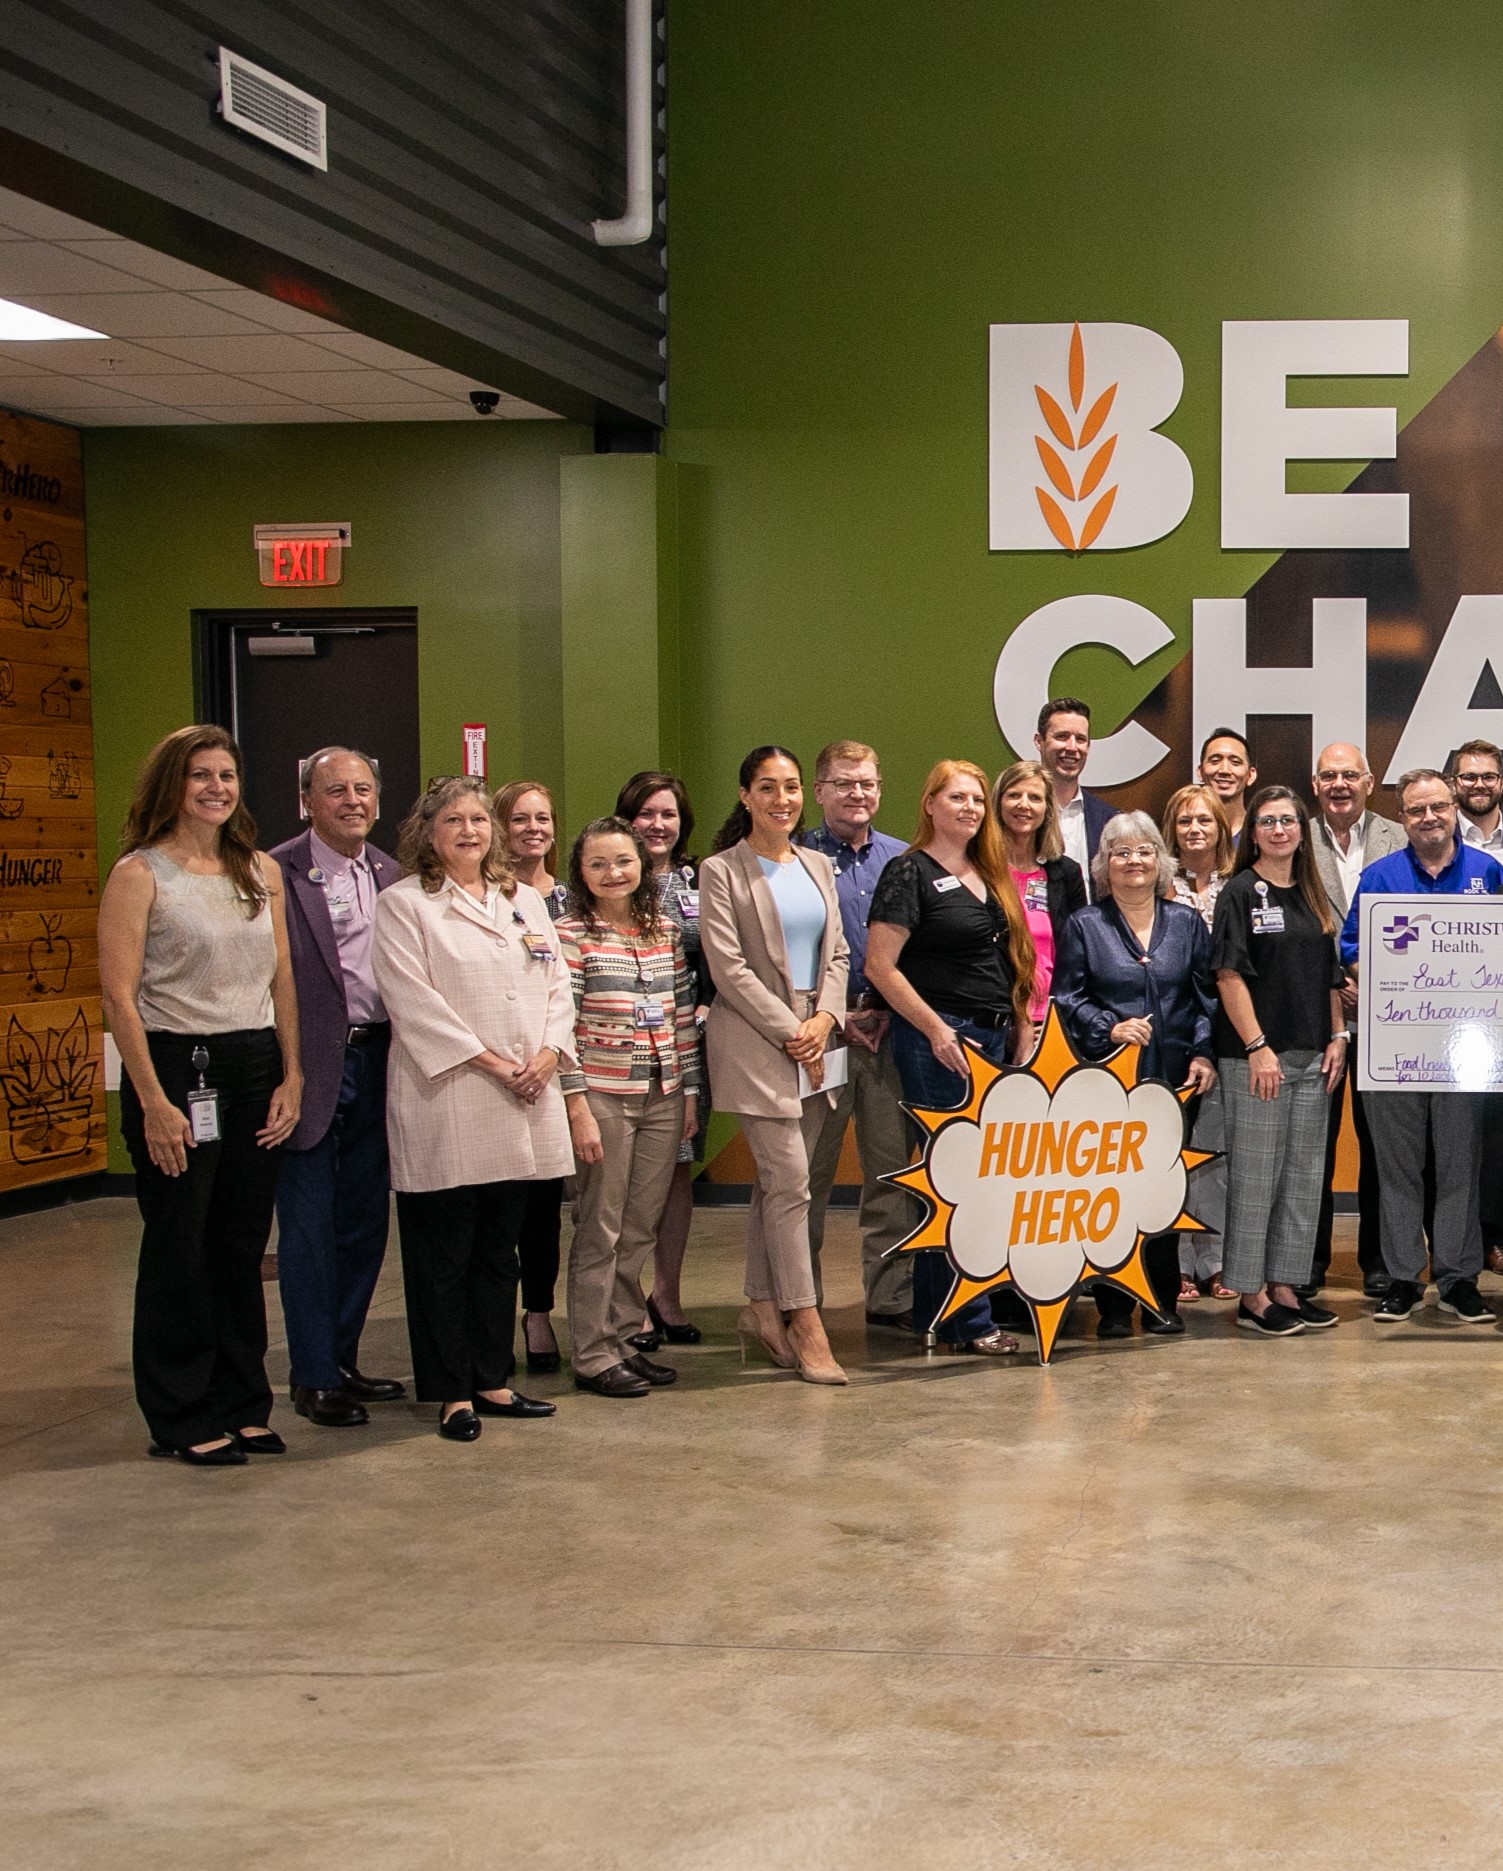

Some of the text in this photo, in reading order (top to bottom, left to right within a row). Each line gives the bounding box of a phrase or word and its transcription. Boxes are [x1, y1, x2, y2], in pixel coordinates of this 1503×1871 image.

[989, 320, 1410, 551] BE
[273, 541, 330, 581] EXIT
[467, 731, 483, 740] FIRE
[1412, 963, 1460, 989] East
[1376, 999, 1417, 1022] Ten
[978, 1120, 1148, 1179] HUNGER
[1009, 1187, 1120, 1247] HERO
